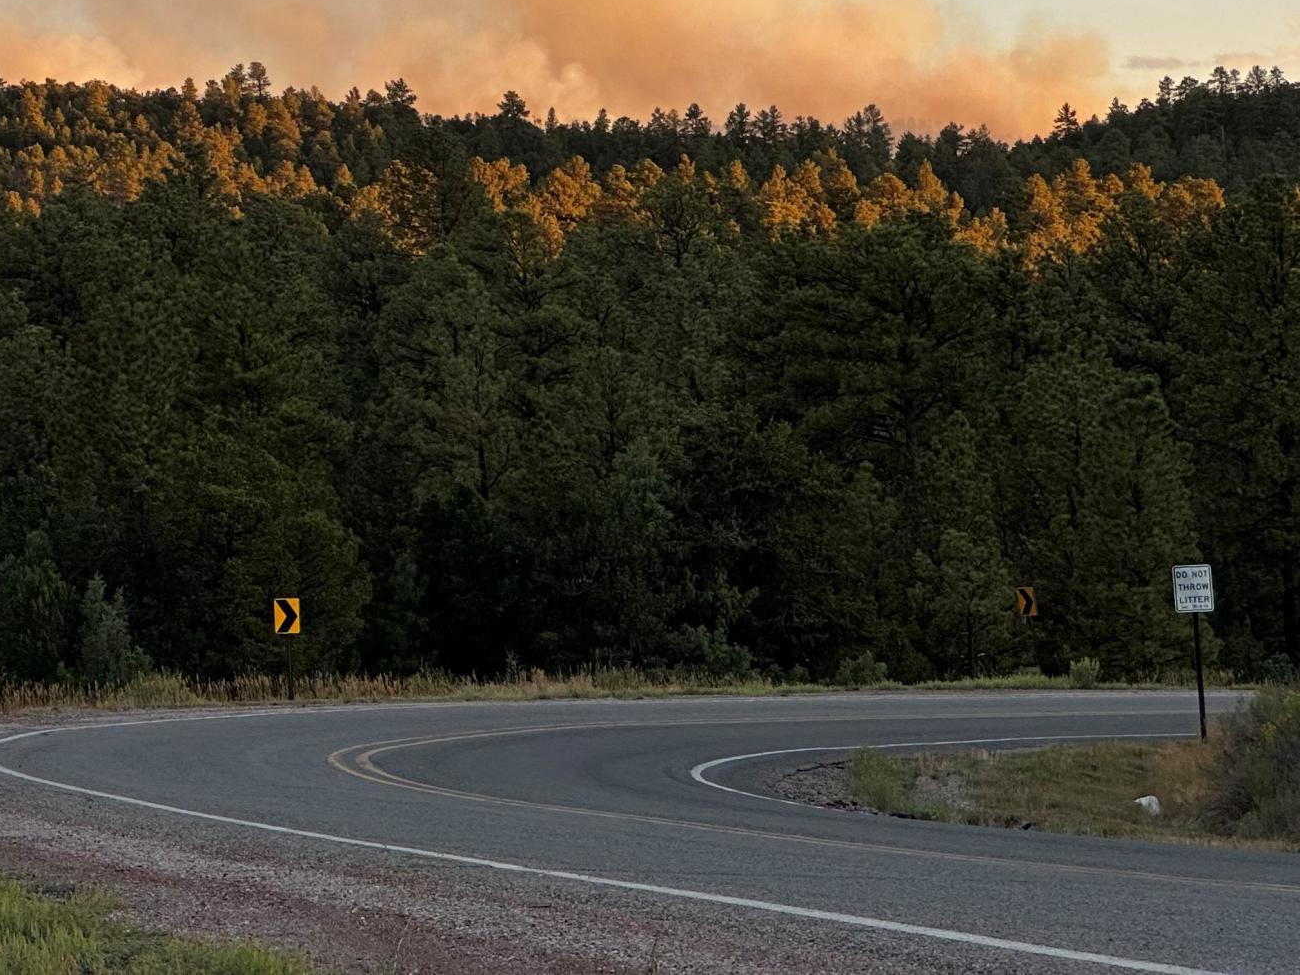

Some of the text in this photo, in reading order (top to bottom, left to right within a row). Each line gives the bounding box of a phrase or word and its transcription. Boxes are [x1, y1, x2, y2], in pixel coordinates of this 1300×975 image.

[1192, 570, 1207, 578] NOT
[1178, 583, 1208, 591] THROW
[1180, 596, 1210, 604] LITTER
